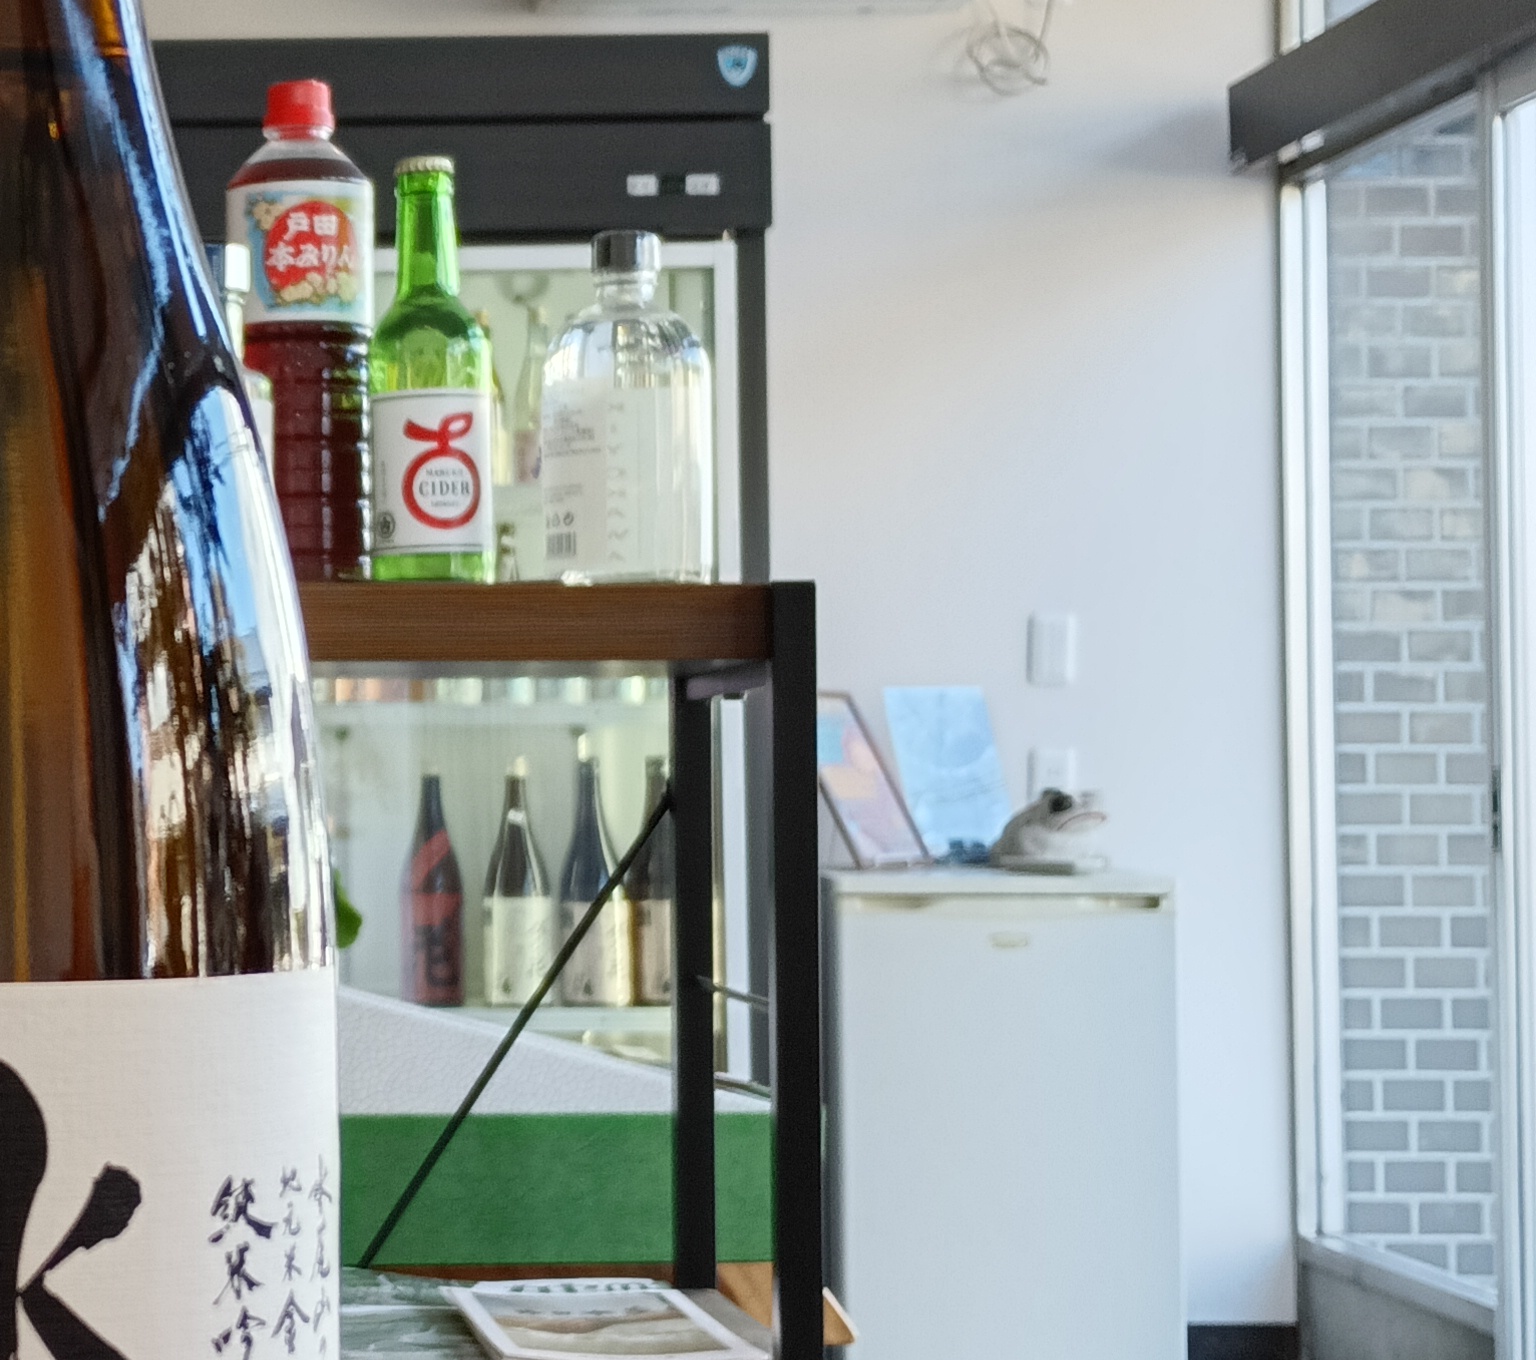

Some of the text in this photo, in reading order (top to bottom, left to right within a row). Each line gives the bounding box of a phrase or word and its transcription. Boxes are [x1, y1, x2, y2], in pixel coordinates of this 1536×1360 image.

[283, 211, 339, 242] 戸田
[266, 240, 355, 277] 本みりん
[418, 480, 471, 497] CIDER
